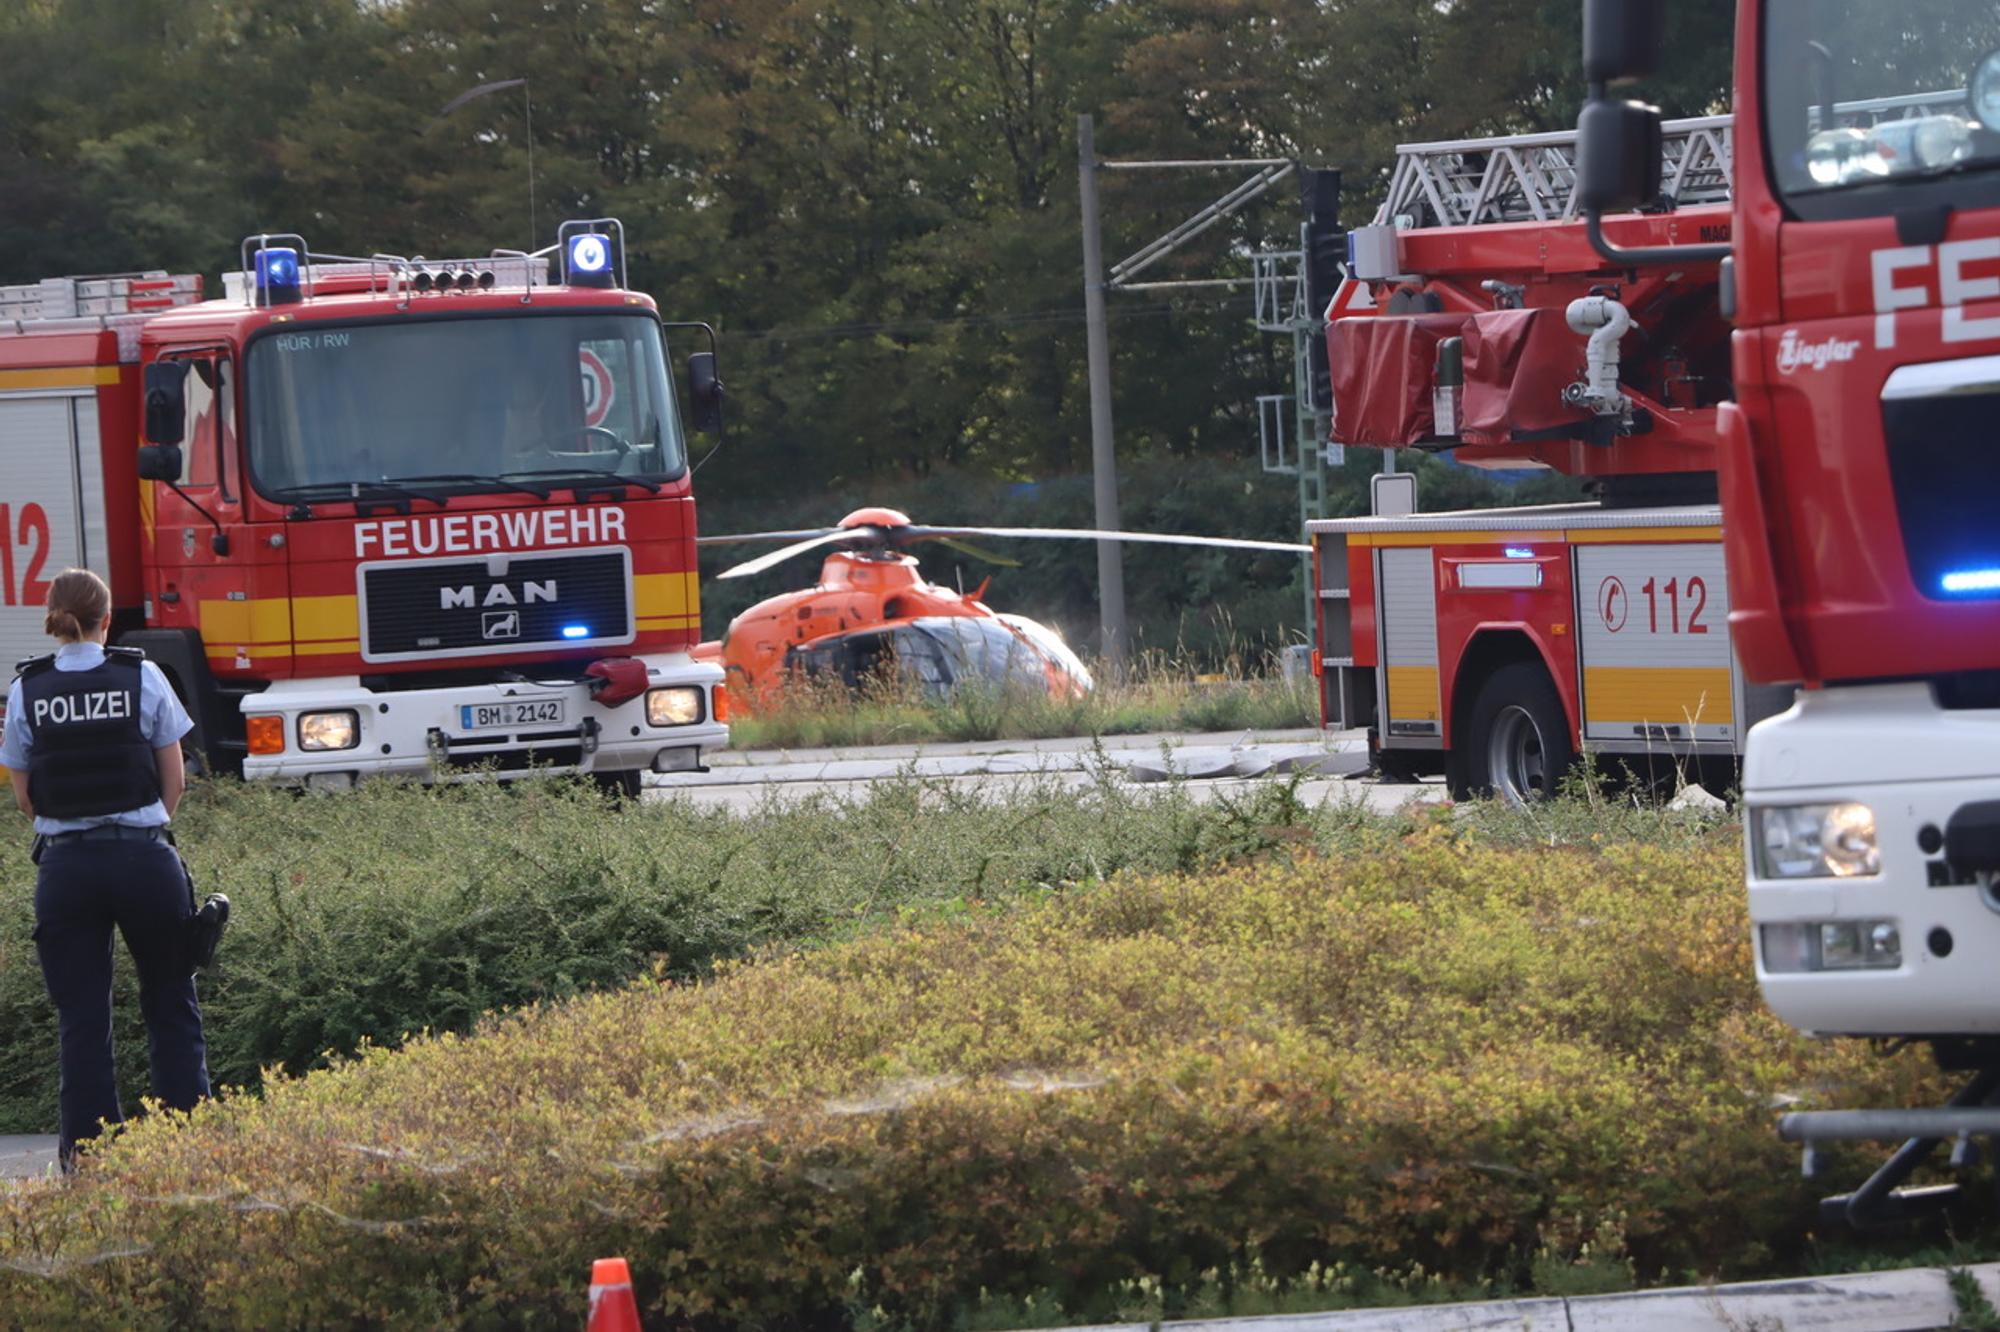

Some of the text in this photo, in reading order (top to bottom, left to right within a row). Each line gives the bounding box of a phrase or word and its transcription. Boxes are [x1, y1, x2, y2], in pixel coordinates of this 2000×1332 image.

[1871, 236, 2000, 349] FE
[323, 333, 349, 349] RW
[1776, 329, 1860, 375] Ziegler
[354, 507, 626, 557] FEUERWEHR
[440, 580, 557, 609] MAN
[1642, 576, 1708, 634] 112
[33, 690, 131, 726] POLIZEI
[478, 703, 558, 725] BM 2142
